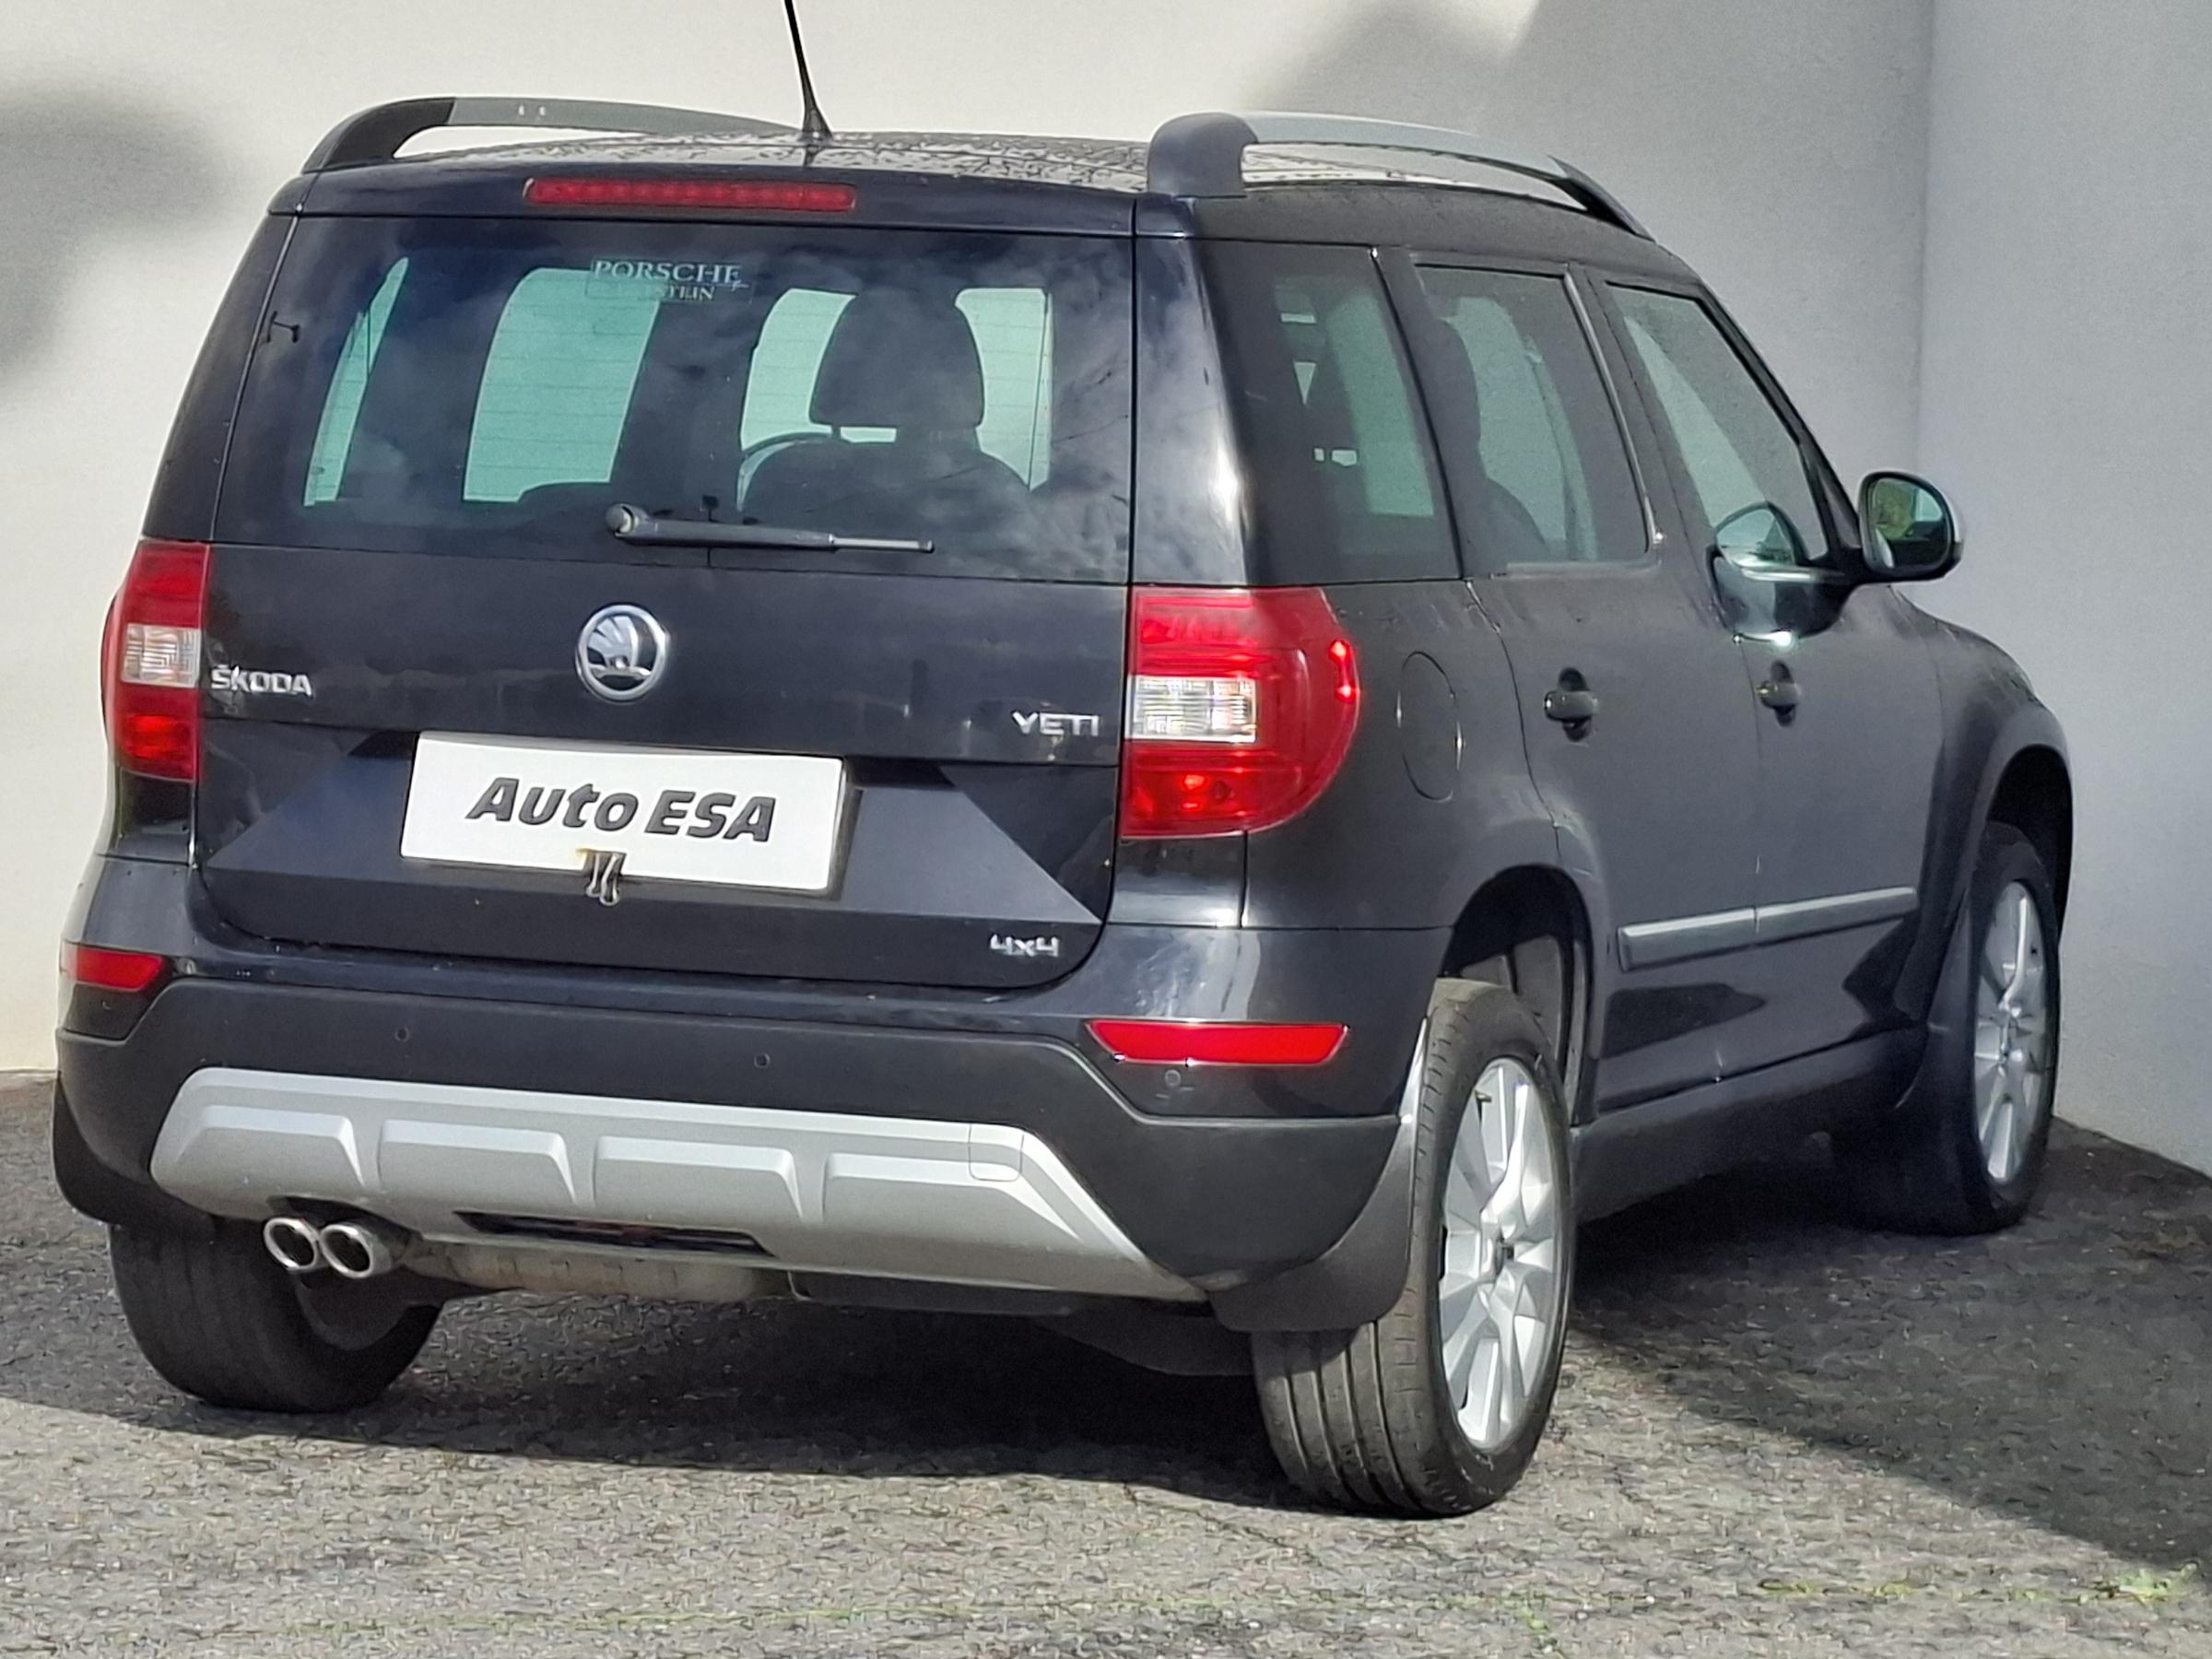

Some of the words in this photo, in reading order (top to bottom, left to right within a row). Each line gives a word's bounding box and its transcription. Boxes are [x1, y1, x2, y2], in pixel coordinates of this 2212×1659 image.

[594, 260, 741, 284] PORSCHE
[1012, 711, 1099, 736] YETI
[465, 776, 639, 831] Auto
[644, 789, 776, 842] ESA
[990, 934, 1059, 957] 4x4
